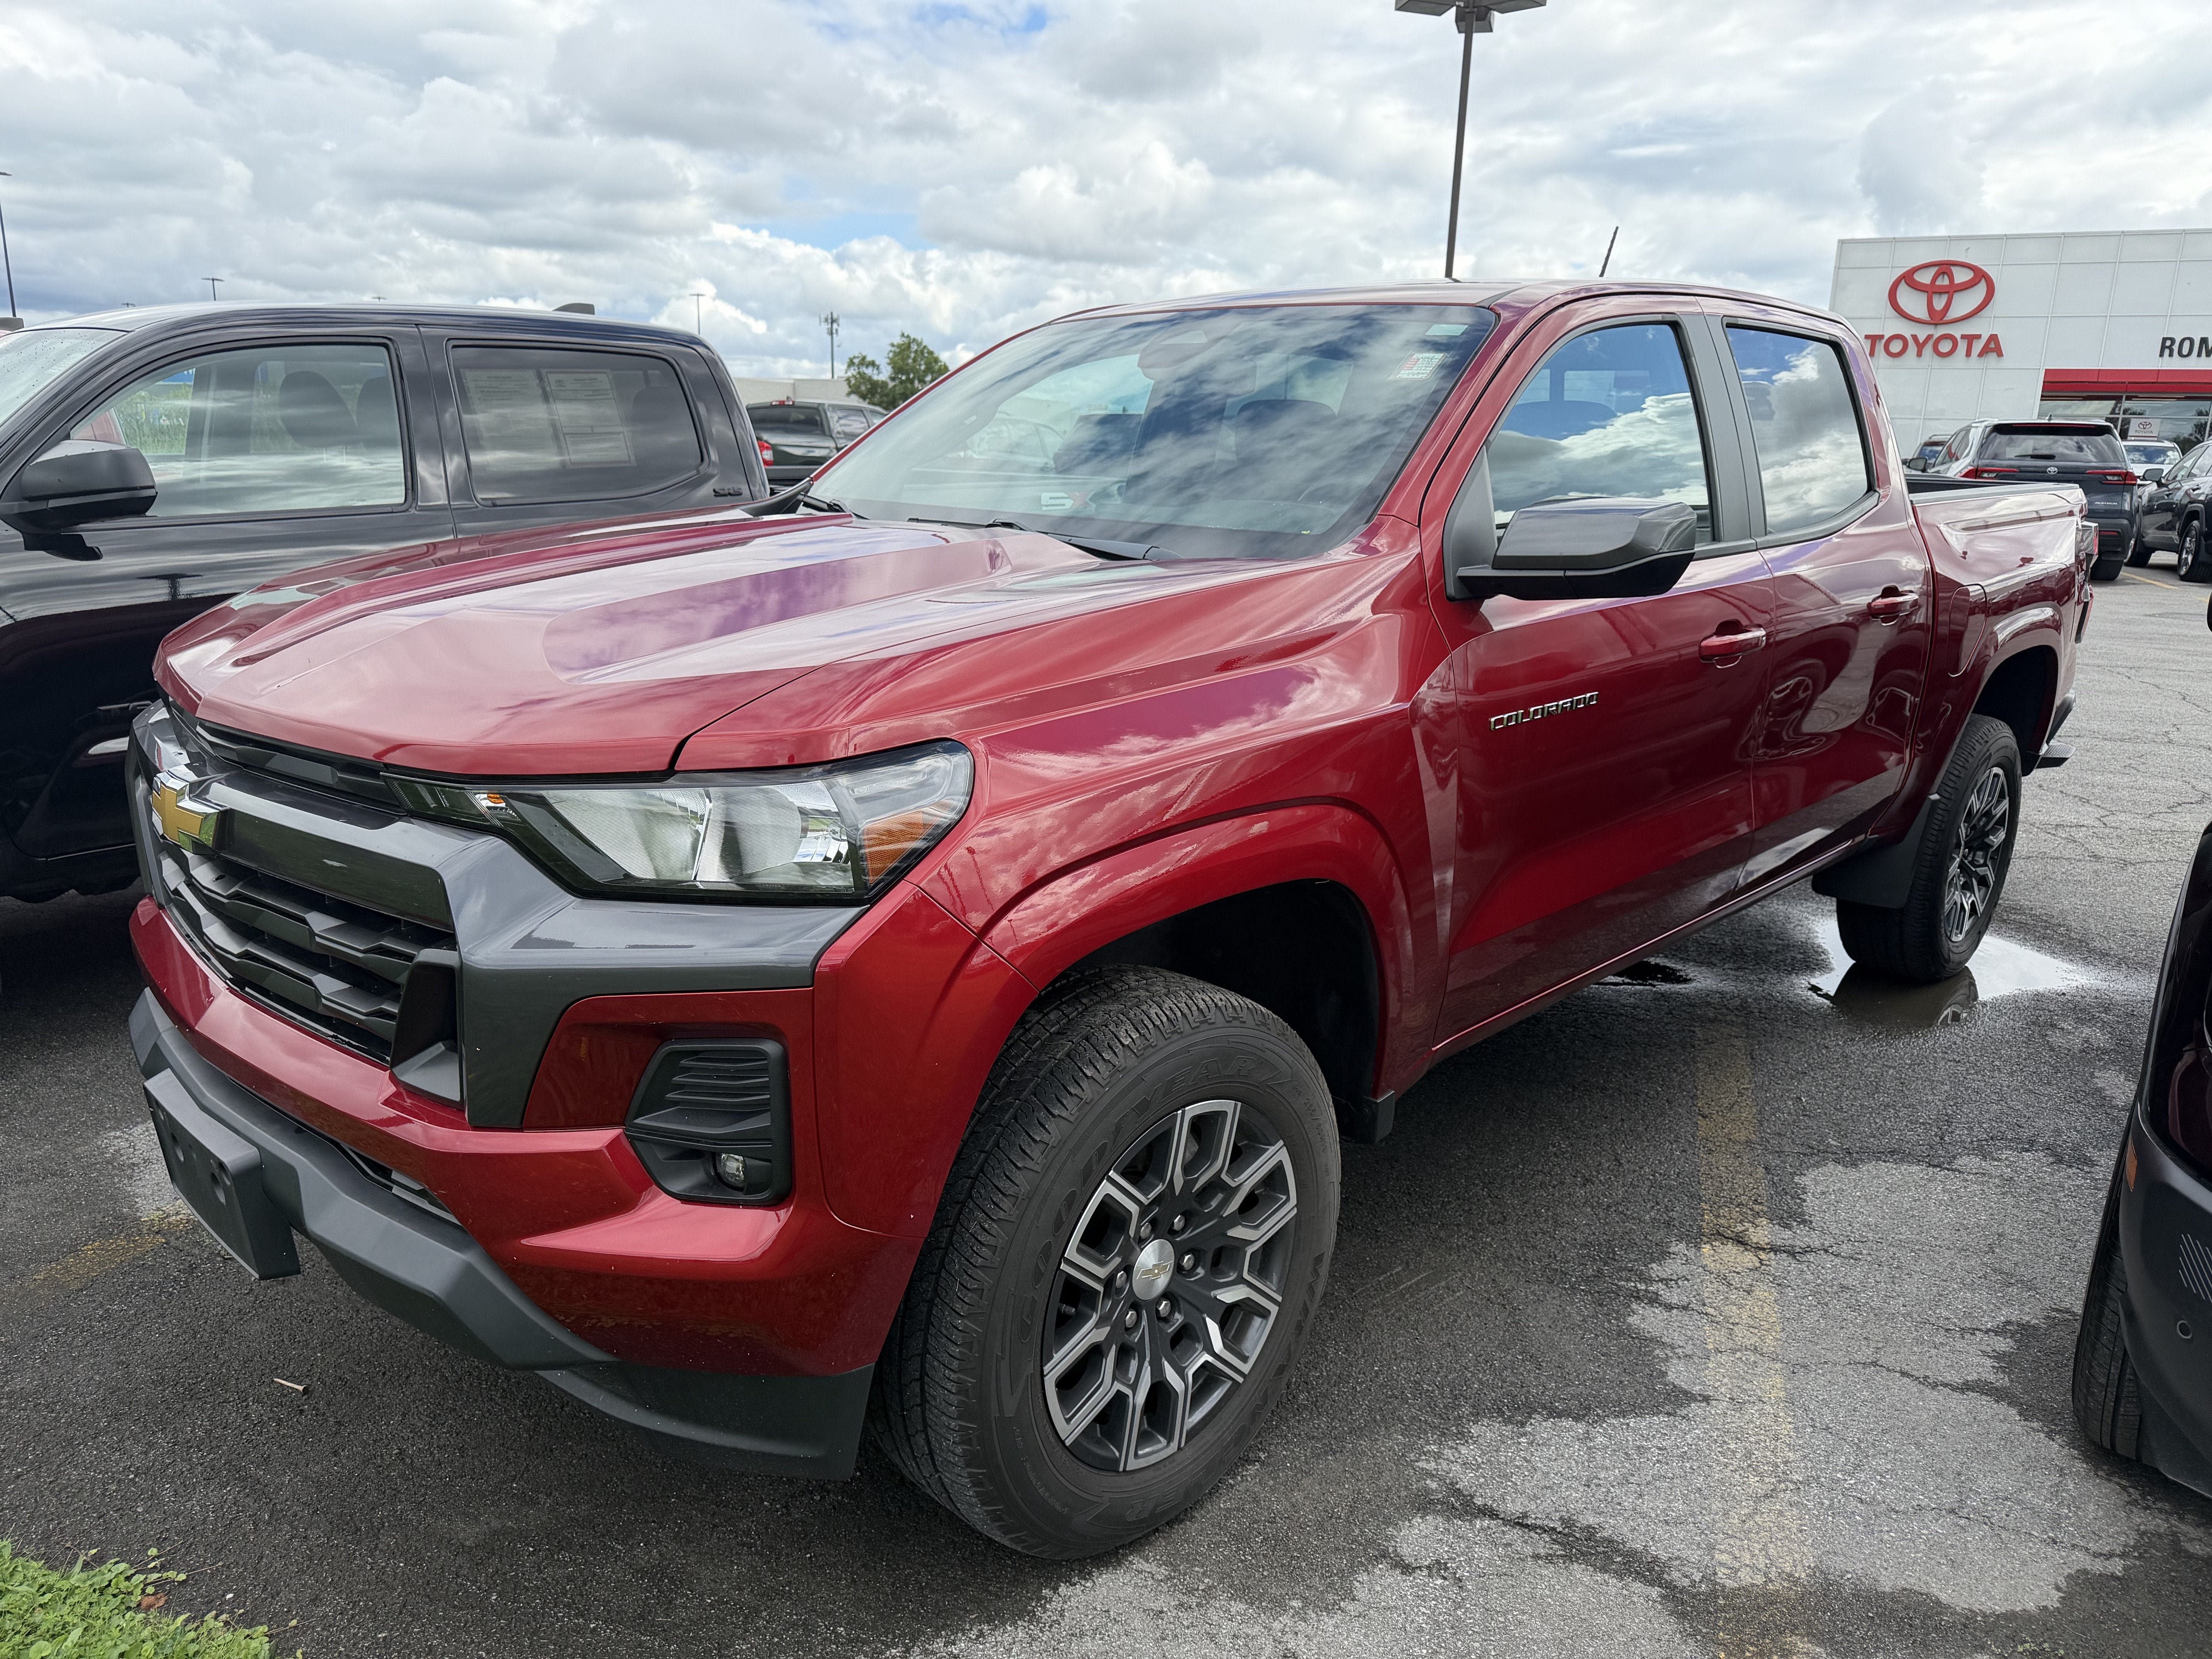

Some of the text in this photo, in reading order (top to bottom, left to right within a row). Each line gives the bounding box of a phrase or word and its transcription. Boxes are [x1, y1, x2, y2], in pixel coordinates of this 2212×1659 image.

[1864, 333, 2004, 358] TOYOTA
[2159, 337, 2212, 358] ROM
[1489, 691, 1599, 731] COLORADO
[1018, 1056, 1257, 1343] GOODYEAR
[1125, 1250, 1326, 1522] WRANGLER
